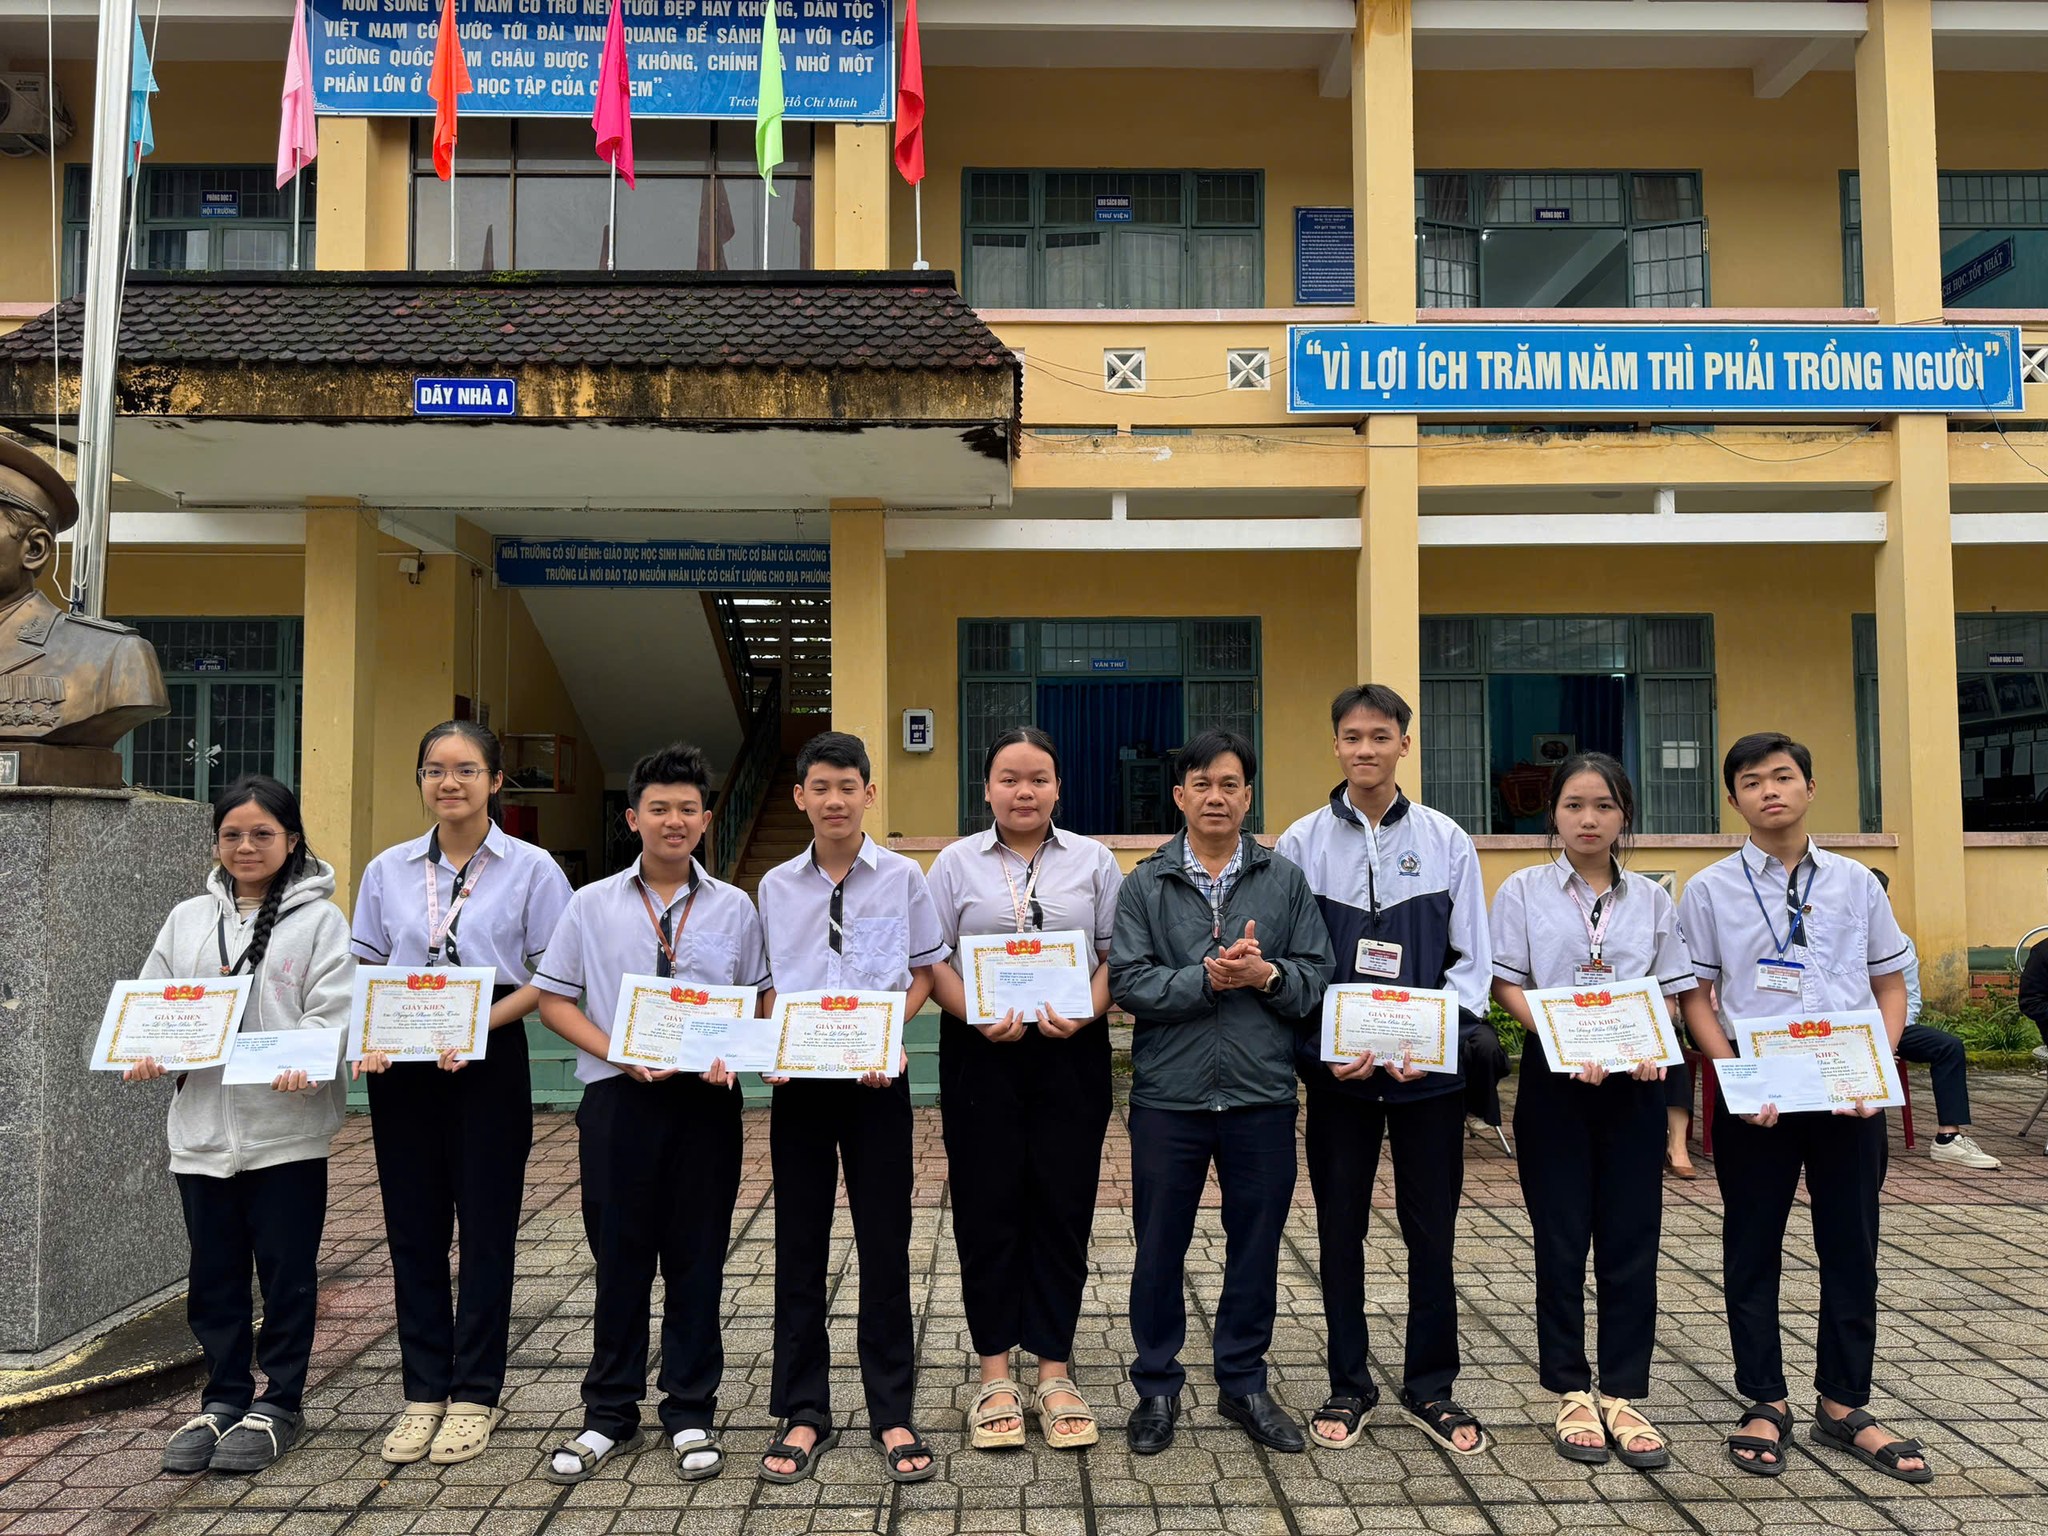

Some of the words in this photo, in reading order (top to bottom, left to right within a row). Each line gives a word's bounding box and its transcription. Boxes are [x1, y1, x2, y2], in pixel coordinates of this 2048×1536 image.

[474, 0, 512, 13] NAM
[664, 0, 696, 19] ĐẸP
[702, 1, 736, 16] HAY
[324, 18, 360, 40] VIỆT
[368, 22, 408, 38] NAM
[417, 20, 439, 40] CÓ
[502, 22, 528, 40] TỚI
[537, 22, 564, 41] ĐÀI
[623, 26, 677, 44] QUANG
[686, 21, 708, 44] ĐỂ
[716, 25, 762, 44] SÁNH
[805, 26, 832, 44] VỚI
[841, 26, 874, 46] CÁC
[325, 44, 380, 65] CƯỜNG
[390, 45, 434, 66] QUỐC
[491, 48, 535, 68] CHÂU
[544, 51, 588, 72] ĐƯỢC
[638, 51, 698, 72] KHÔNG,
[708, 52, 758, 70] CHÍNH
[796, 53, 830, 72] NHỜ
[839, 54, 874, 76] MỘT
[324, 71, 368, 92] PHẦN
[374, 73, 406, 92] LỚN
[410, 72, 422, 93] Ở
[478, 78, 510, 98] HỌC
[515, 76, 546, 98] TẬP
[551, 75, 585, 96] CỦA
[729, 96, 758, 107] Trích
[784, 95, 800, 108] Hồ
[804, 96, 825, 108] Chí
[828, 97, 858, 108] Minh
[1360, 346, 1406, 399] LỢI
[1417, 342, 1467, 390] ÍCH
[1476, 343, 1562, 390] TRĂM
[1568, 343, 1638, 390] NĂM
[1648, 343, 1695, 390] THÌ
[1704, 338, 1774, 390] PHẢI
[1783, 338, 1884, 391] TRỒNG
[421, 384, 454, 404] DÃY
[458, 384, 492, 405] NHÀ
[496, 388, 508, 405] A
[502, 544, 518, 559] NHÀ
[521, 544, 551, 559] TRƯỜNG
[552, 544, 564, 559] CÓ
[565, 544, 576, 559] SỨ
[578, 545, 602, 563] MỆNH:
[604, 544, 622, 560] GIÁO
[624, 548, 639, 563] DỤC
[641, 548, 657, 563] HỌC
[659, 548, 677, 560] SINH
[679, 545, 705, 560] NHỮNG
[708, 544, 726, 560] KIẾN
[727, 545, 748, 561] THỨC
[749, 548, 760, 561] CƠ
[762, 545, 777, 561] BẢN
[778, 545, 794, 561] CỦA
[796, 548, 826, 562] CHƯƠNG
[545, 565, 576, 580] TRƯỜNG
[578, 565, 588, 581] LÀ
[590, 566, 603, 581] NƠI
[605, 565, 621, 581] ĐÀO
[623, 569, 638, 584] TẠO
[640, 564, 666, 582] NGUỒN
[668, 566, 689, 582] NHÂN
[692, 567, 706, 585] LỰC
[708, 566, 718, 582] CÓ
[721, 565, 740, 582] CHẤT
[742, 568, 767, 586] LƯỢNG
[768, 571, 784, 582] CHO
[786, 571, 799, 586] ĐỊA
[800, 569, 831, 583] PHƯƠNG
